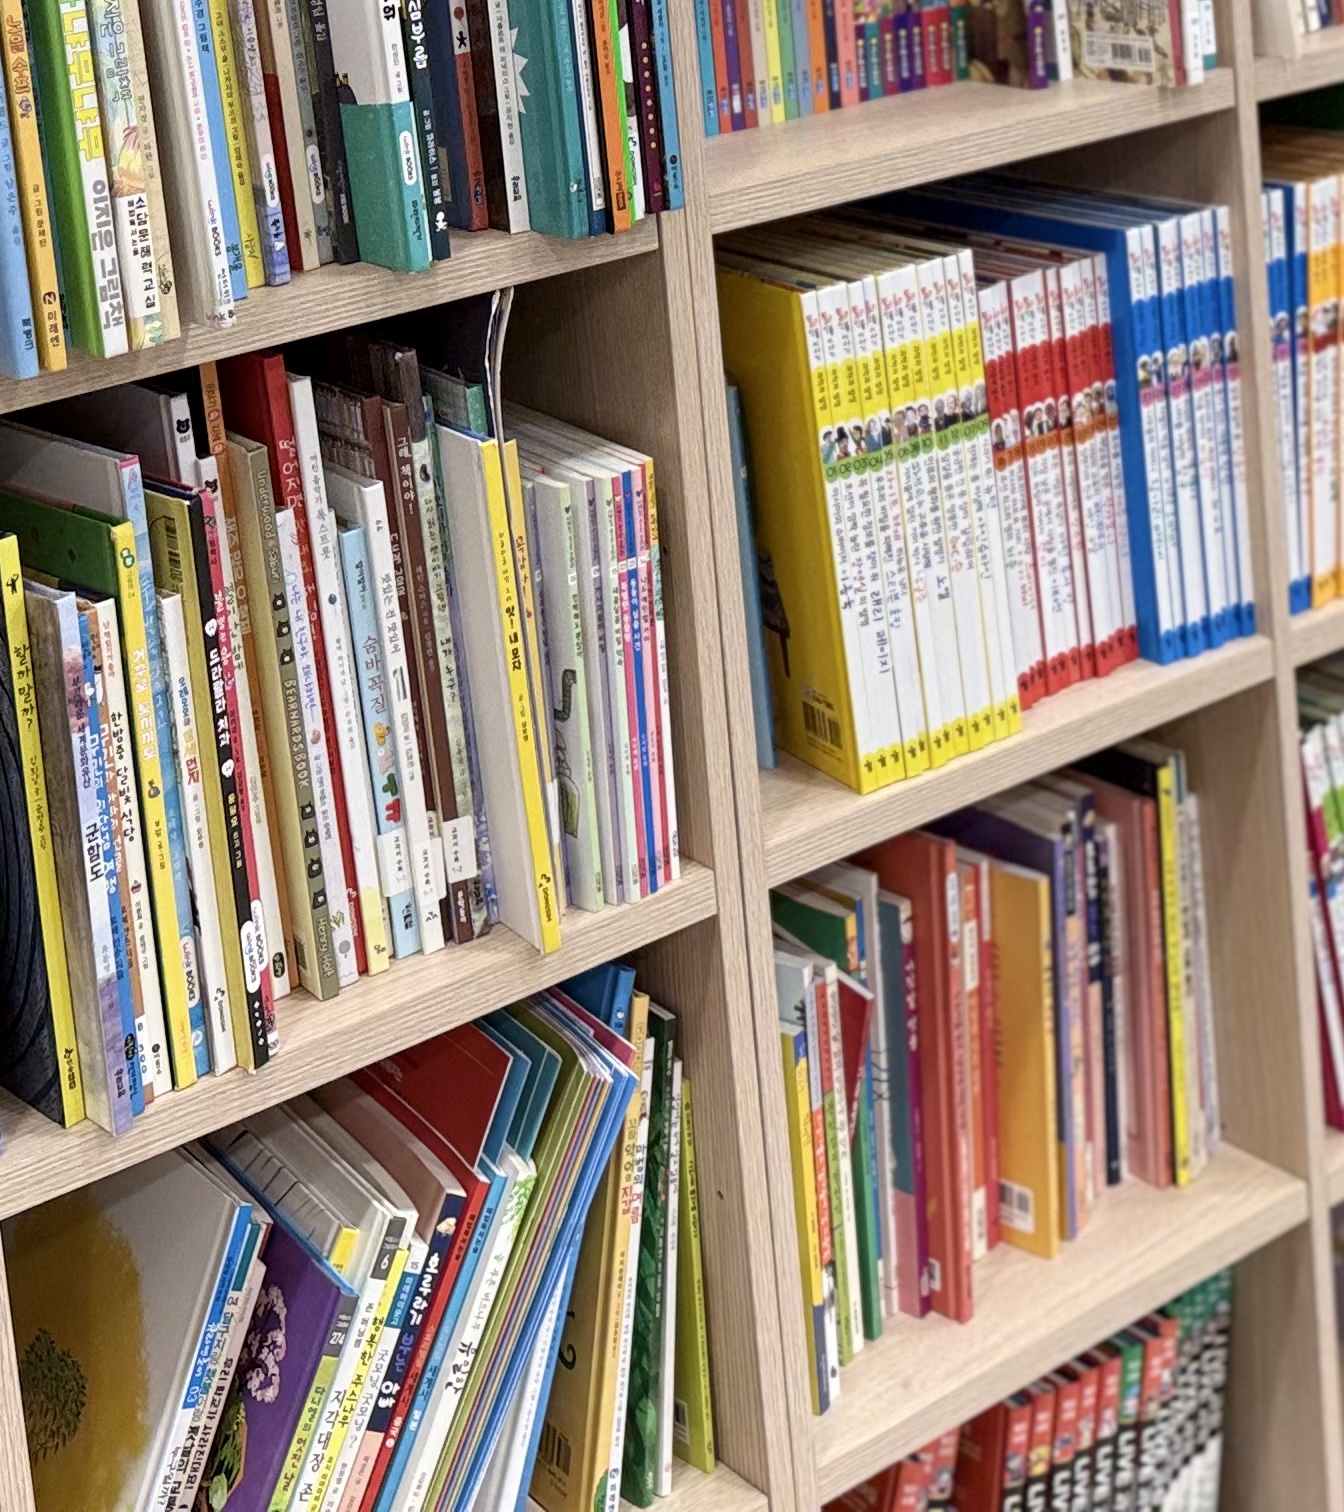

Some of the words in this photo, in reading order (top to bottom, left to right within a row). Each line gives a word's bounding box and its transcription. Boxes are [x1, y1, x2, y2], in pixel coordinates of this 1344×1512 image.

[92, 179, 113, 251] 이지은
[96, 254, 127, 330] 그림책
[13, 646, 32, 680] 할까
[361, 635, 388, 716] 숨바꼭질
[17, 686, 37, 730] 말까?
[110, 711, 127, 761] 한밤중
[115, 766, 131, 806] 달빛
[294, 752, 310, 790] BOOK
[85, 823, 104, 883] 군함도
[308, 1389, 347, 1474] 지각대장
[298, 1479, 317, 1503] 존
